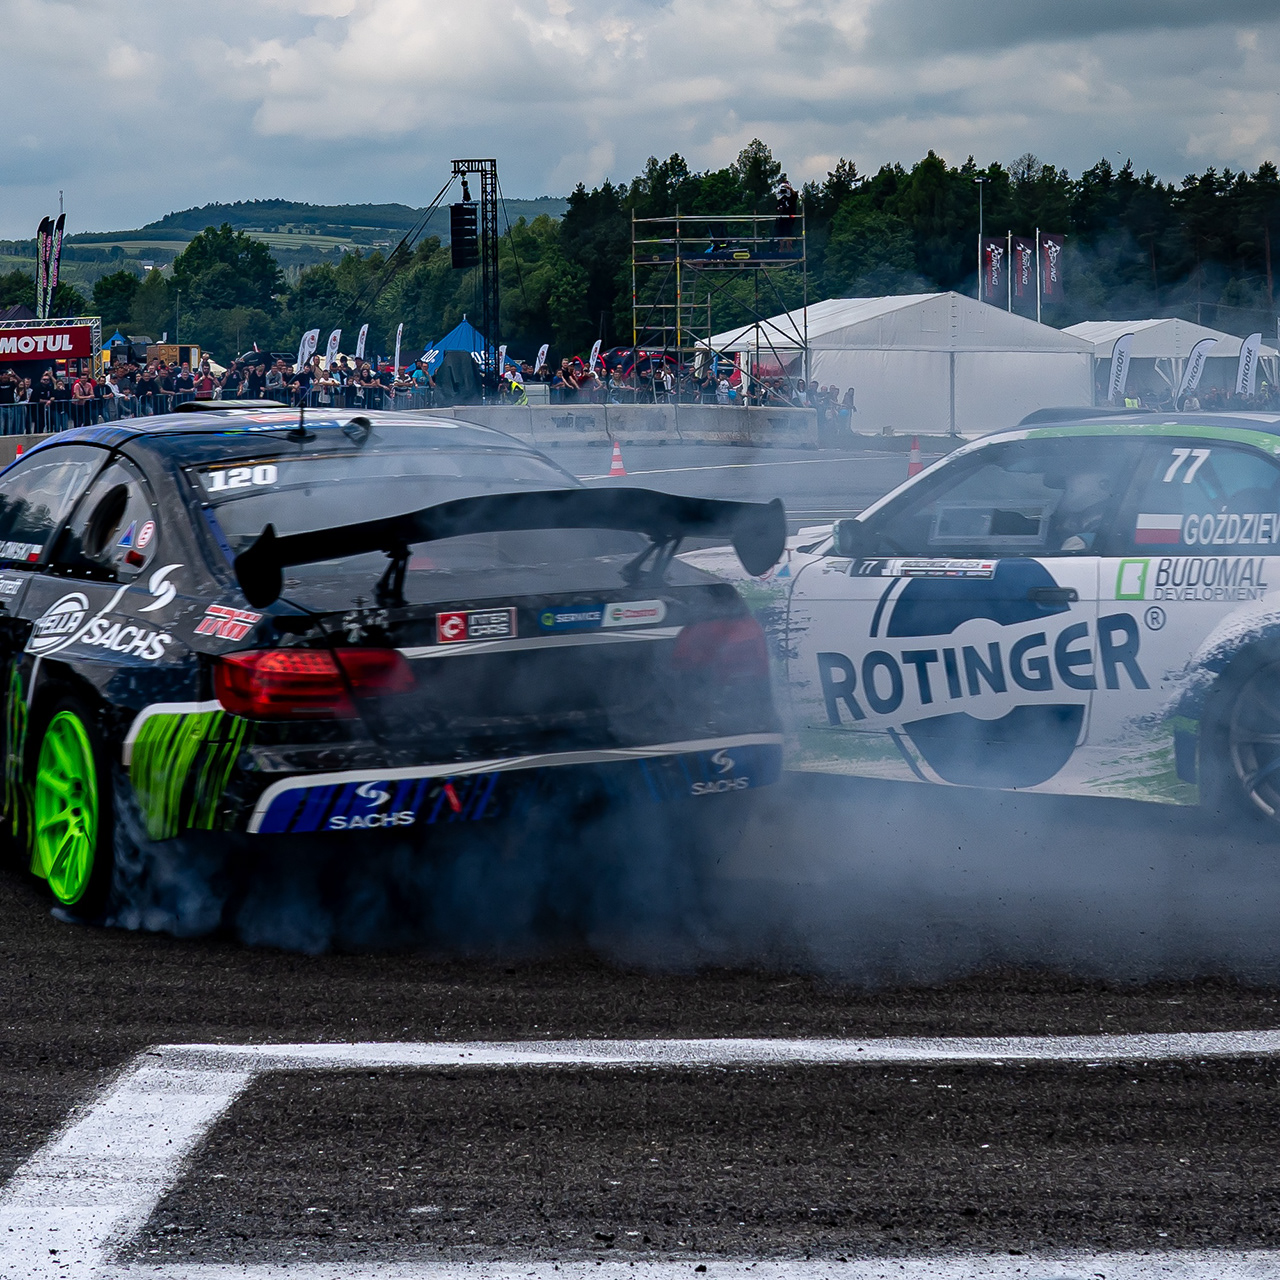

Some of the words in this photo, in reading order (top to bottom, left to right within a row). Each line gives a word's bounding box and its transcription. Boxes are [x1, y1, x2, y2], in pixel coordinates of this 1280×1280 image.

[1162, 447, 1211, 484] 77
[207, 464, 278, 492] 120
[858, 561, 879, 574] 77
[1154, 557, 1268, 588] BUDOMAL
[1153, 587, 1269, 601] DEVELOPMENT
[35, 611, 86, 635] HELLA
[193, 604, 263, 641] TRW
[470, 611, 509, 625] INTER
[555, 611, 602, 623] SERVICE
[81, 619, 173, 660] SACHS
[469, 624, 510, 636] CARS
[816, 612, 1151, 726] ROTINGER
[690, 776, 750, 796] SACHS
[328, 810, 416, 830] SACHS
